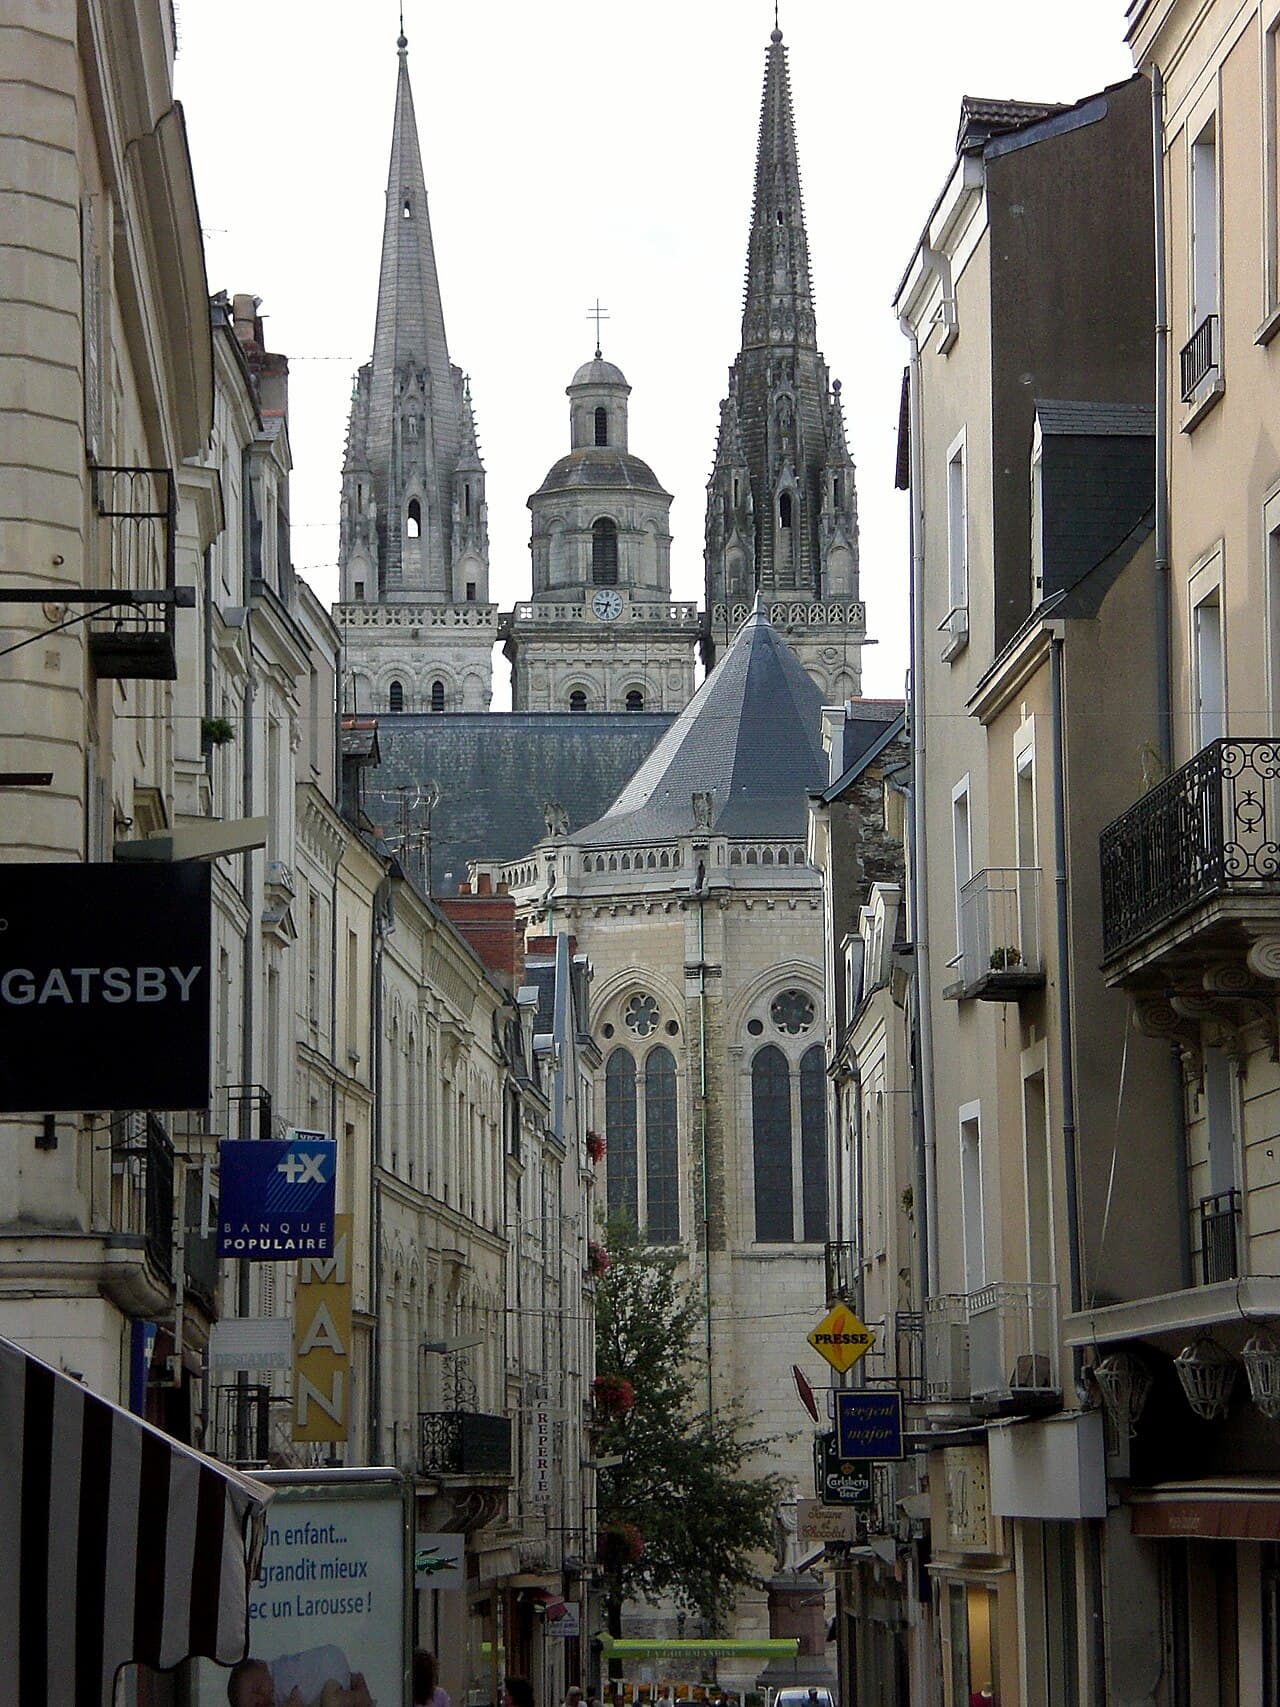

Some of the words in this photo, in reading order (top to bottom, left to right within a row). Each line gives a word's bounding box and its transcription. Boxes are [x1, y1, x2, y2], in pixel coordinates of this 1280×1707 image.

[1, 966, 203, 1005] GATSBY
[223, 1221, 328, 1235] BANQUE
[223, 1237, 328, 1251] POPULAIRE
[814, 1332, 869, 1346] PRESSE
[847, 1427, 893, 1444] major
[826, 1473, 870, 1490] Carlsberg
[837, 1488, 861, 1499] Beer
[258, 1558, 317, 1589] grandit
[320, 1557, 369, 1580] mieux
[272, 1601, 292, 1618] un
[296, 1594, 364, 1617] Larousse
